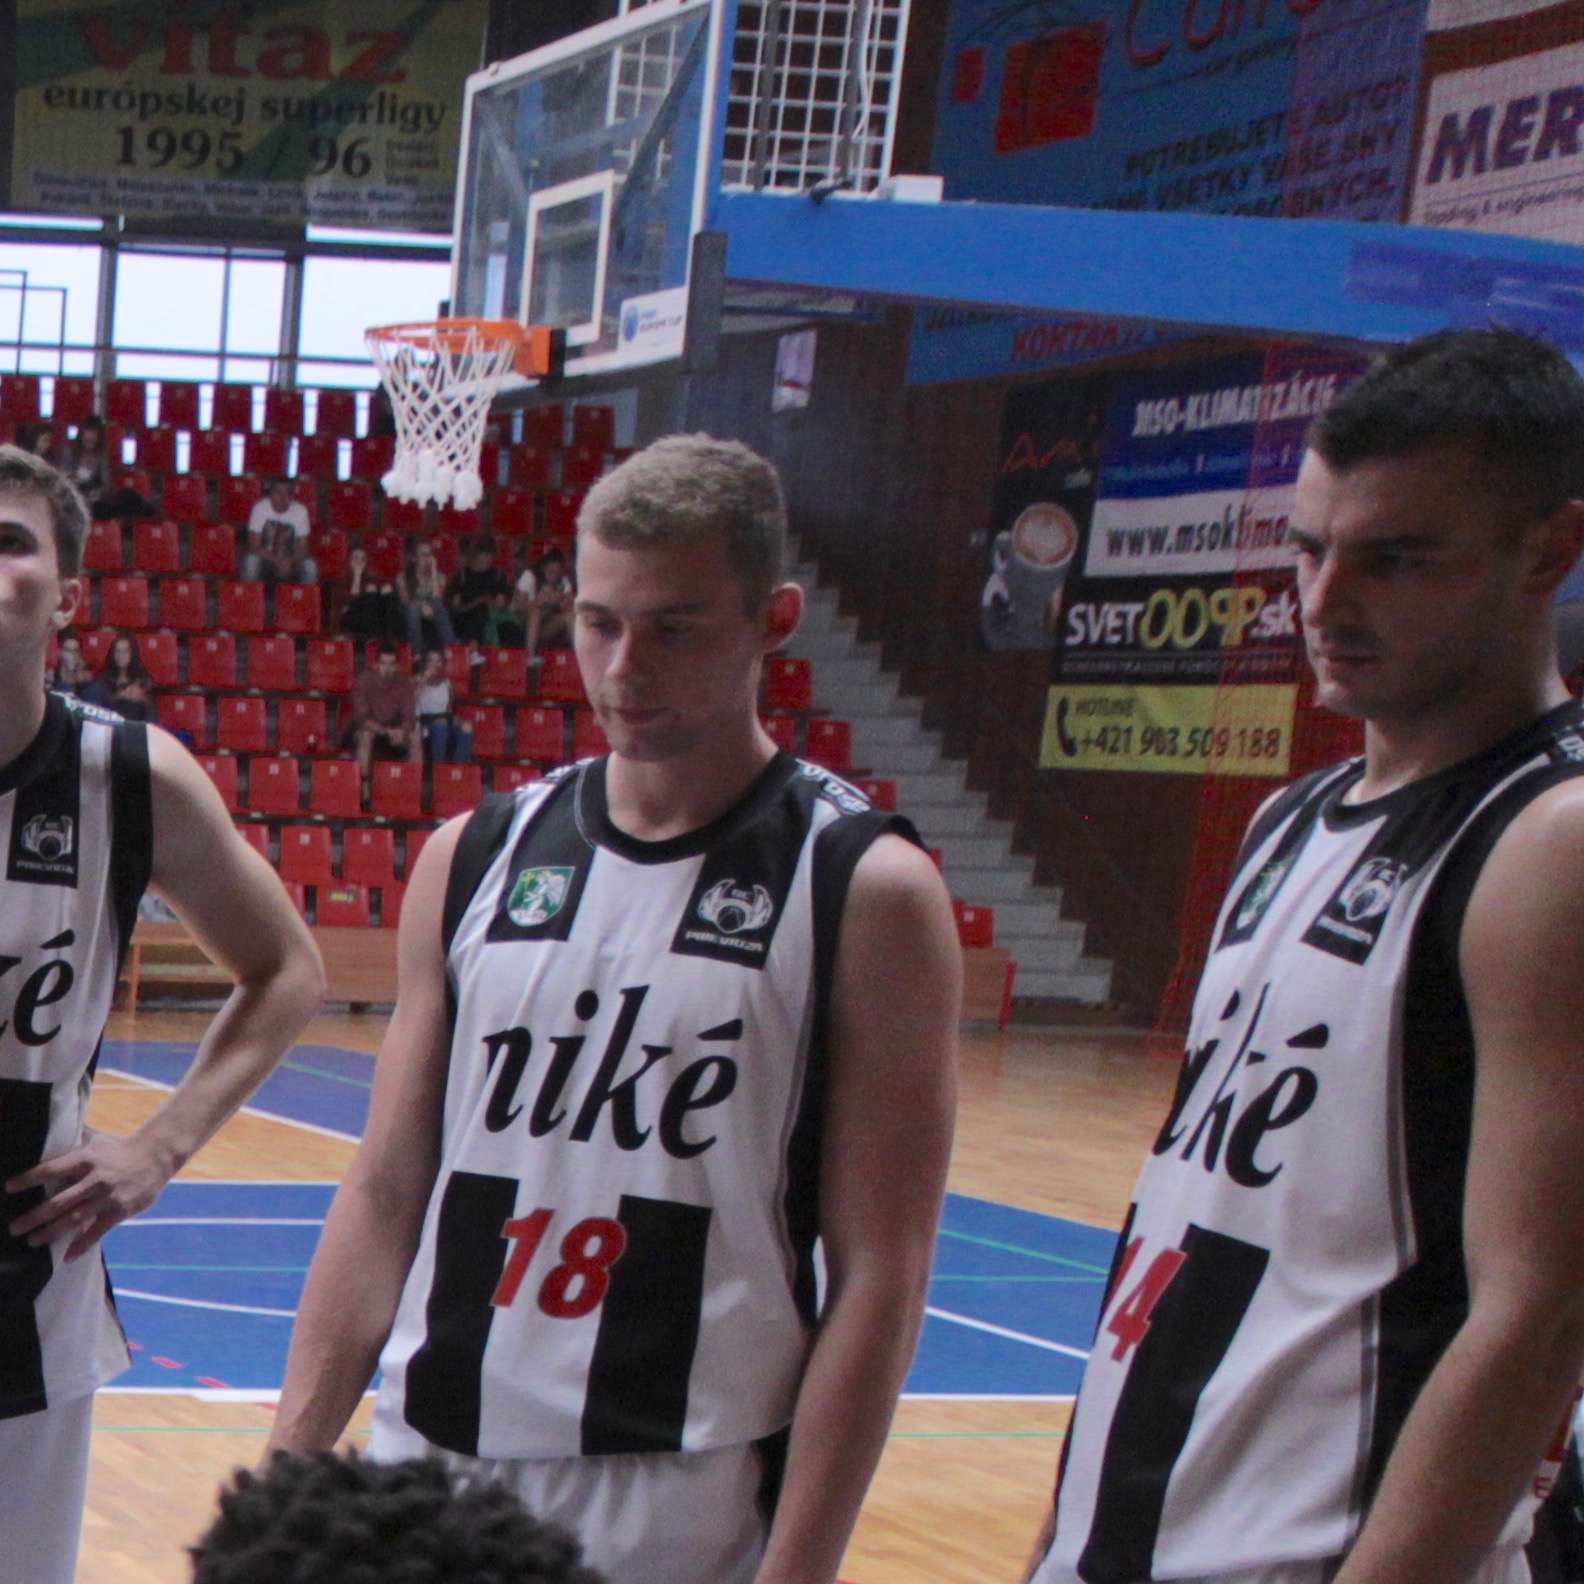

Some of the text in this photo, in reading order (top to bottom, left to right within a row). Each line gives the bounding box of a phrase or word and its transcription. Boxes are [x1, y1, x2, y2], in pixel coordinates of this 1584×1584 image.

[261, 87, 447, 134] superligy
[1425, 84, 1584, 186] MER
[115, 126, 246, 173] 1995
[307, 136, 374, 179] 96
[1081, 724, 1132, 758] +421
[1184, 724, 1229, 759] 509
[1235, 727, 1282, 760] 188
[480, 984, 744, 1160] niké
[490, 1207, 629, 1321] 18
